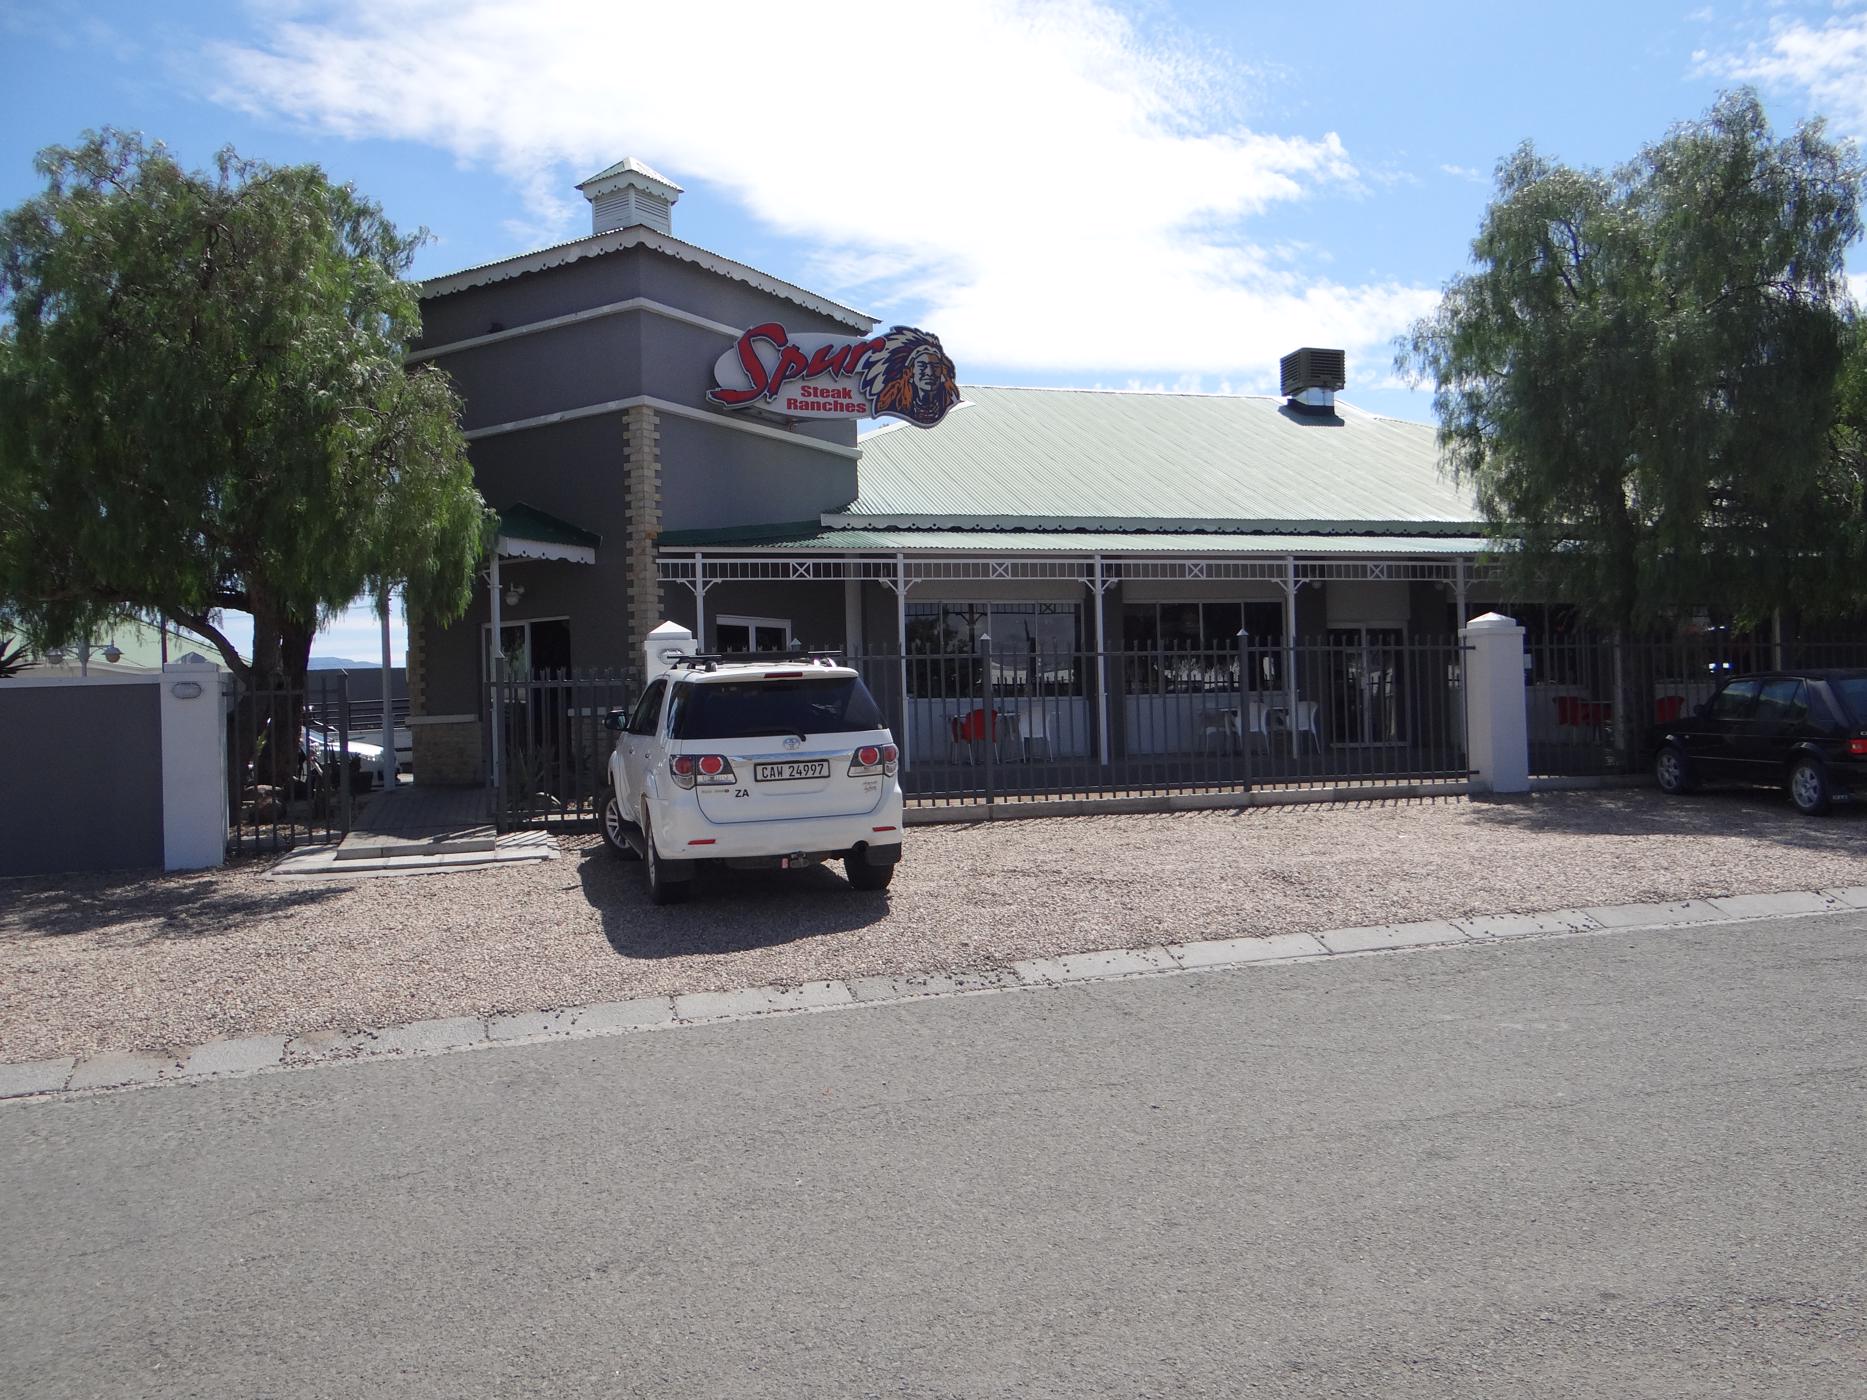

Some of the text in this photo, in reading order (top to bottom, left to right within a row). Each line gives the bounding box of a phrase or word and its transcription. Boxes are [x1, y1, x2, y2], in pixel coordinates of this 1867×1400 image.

[708, 322, 887, 405] Spur
[800, 385, 852, 399] Steak
[786, 398, 867, 413] Ranches
[761, 763, 824, 779] CAW 24997
[735, 789, 750, 798] ZA
